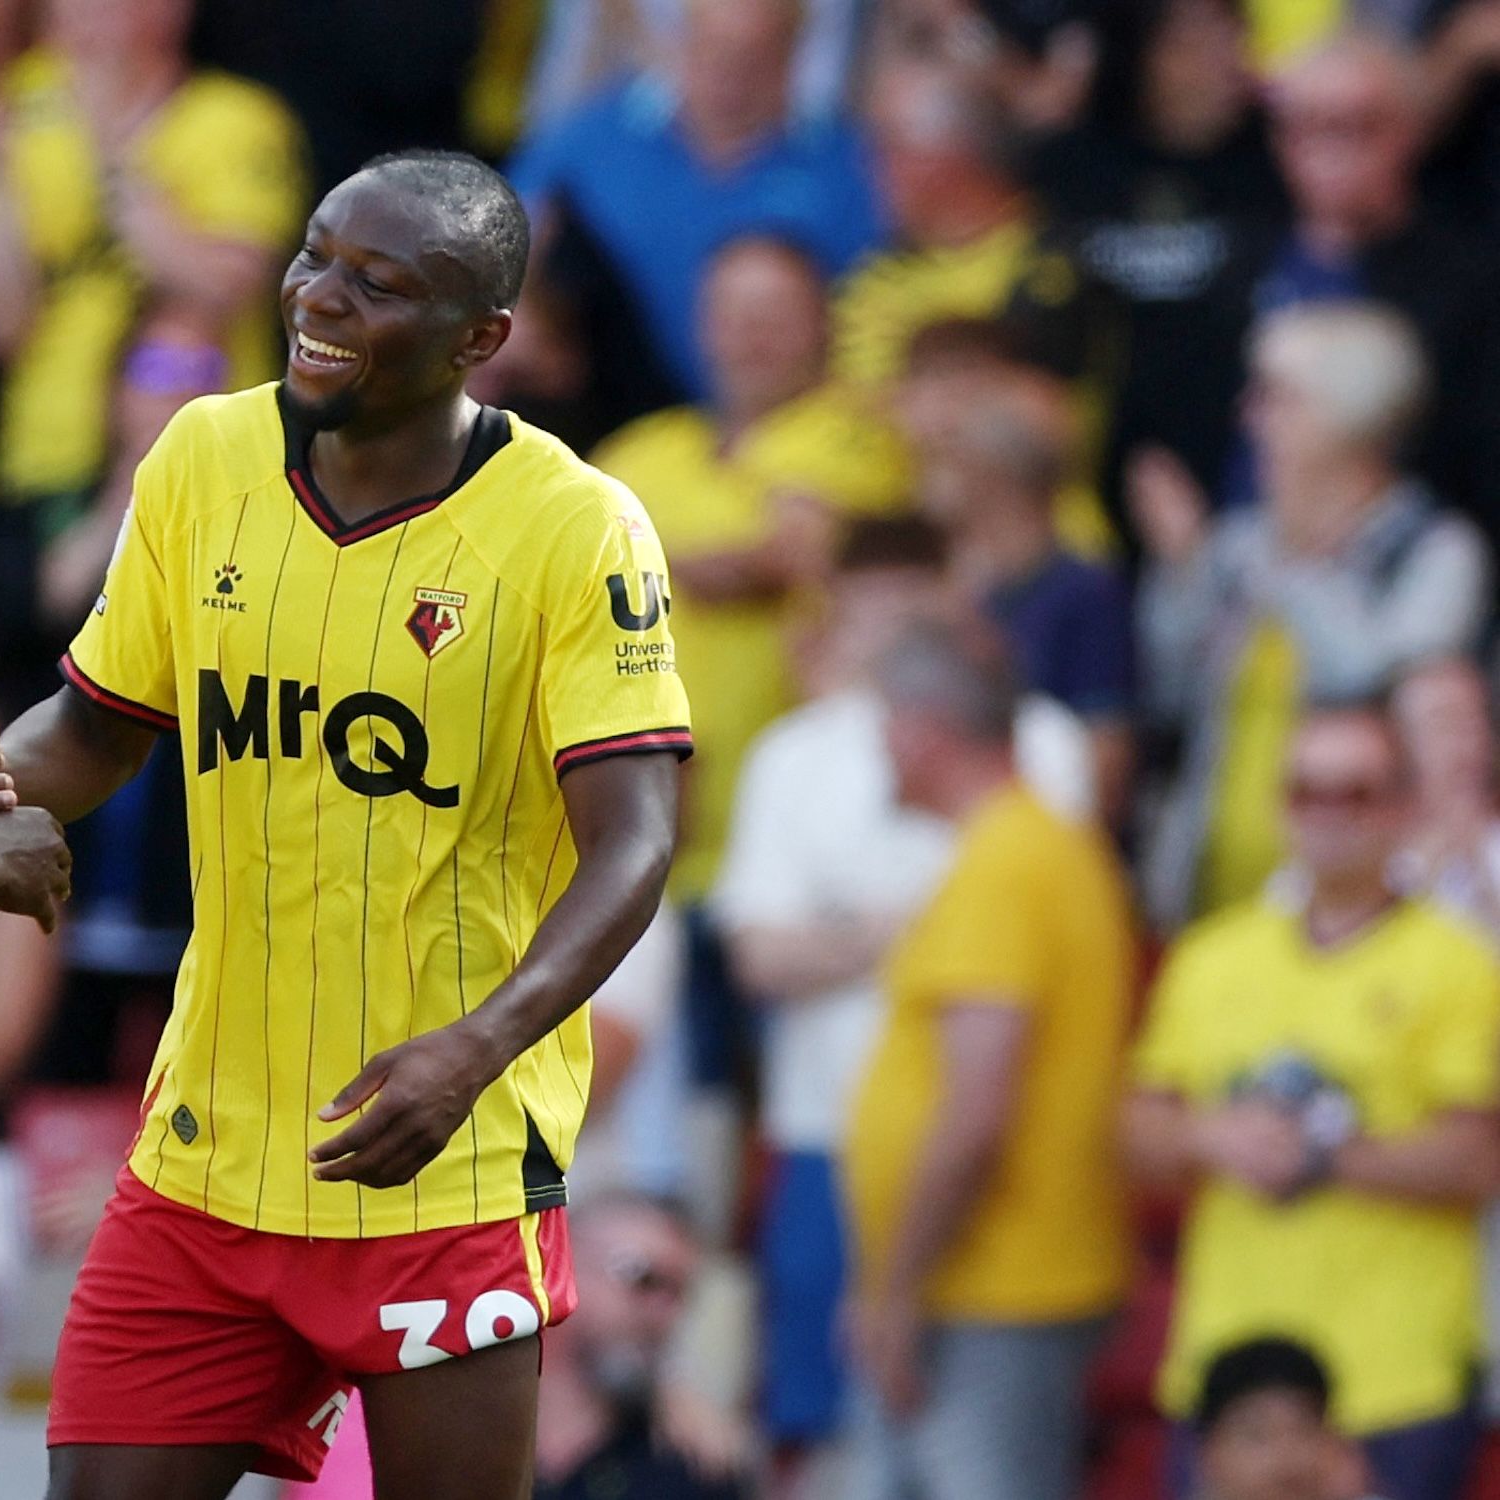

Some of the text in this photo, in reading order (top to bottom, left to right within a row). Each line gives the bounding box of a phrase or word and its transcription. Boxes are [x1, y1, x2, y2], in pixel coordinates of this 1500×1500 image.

[202, 597, 247, 613] KELME
[419, 591, 463, 604] WATFORD
[605, 571, 670, 631] U
[616, 658, 677, 676] Hertfor
[198, 668, 460, 808] MrQ
